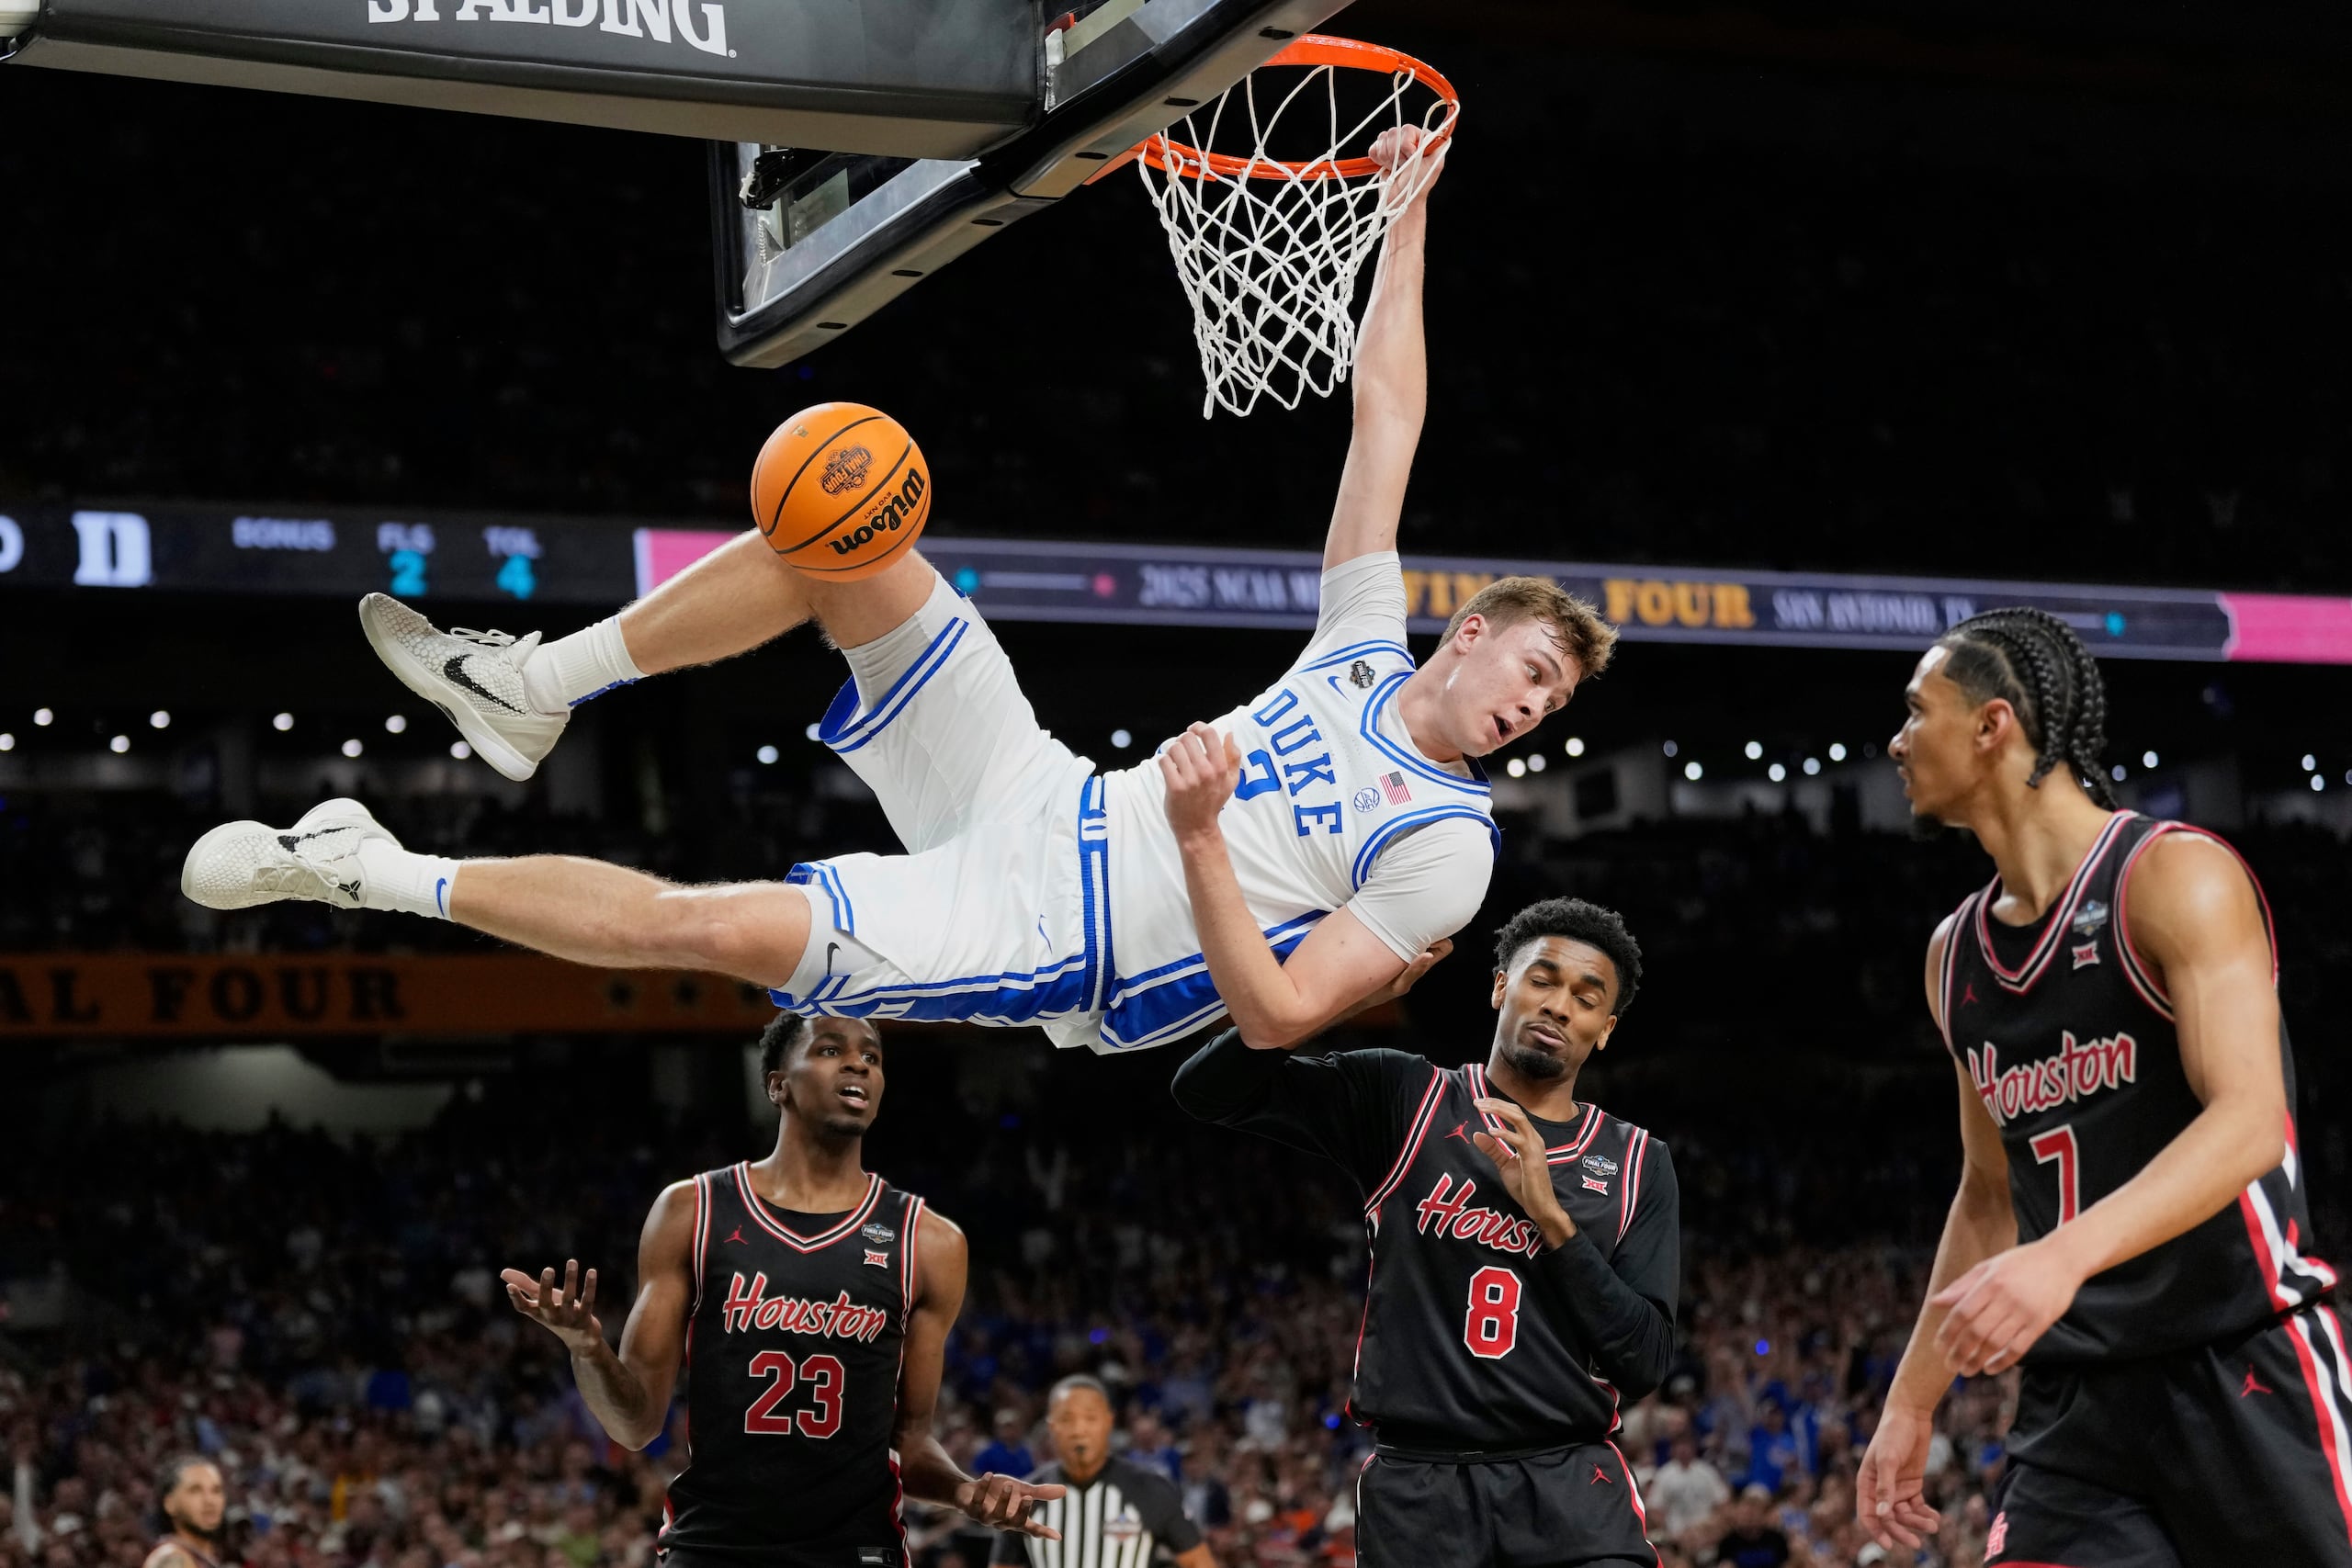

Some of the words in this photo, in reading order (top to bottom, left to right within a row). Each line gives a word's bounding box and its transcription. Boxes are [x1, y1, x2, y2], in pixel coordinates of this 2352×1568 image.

[232, 515, 336, 551] BONUS
[830, 468, 925, 555] Wilson
[864, 505, 878, 520] NXT
[878, 491, 892, 505] EVO
[390, 548, 428, 596] 2
[495, 553, 537, 599] 4
[1603, 579, 1757, 628] FOUR
[1250, 688, 1342, 837] DUKE
[148, 967, 405, 1022] FOUR
[1967, 1030, 2136, 1127] Houston
[1585, 1159, 1600, 1168] FINAL
[1600, 1163, 1616, 1171] FOUR
[2029, 1124, 2079, 1228] 7
[1416, 1172, 1544, 1260] Hous
[723, 1271, 887, 1344] Houston
[1464, 1266, 1522, 1359] 8
[744, 1350, 844, 1438] 23
